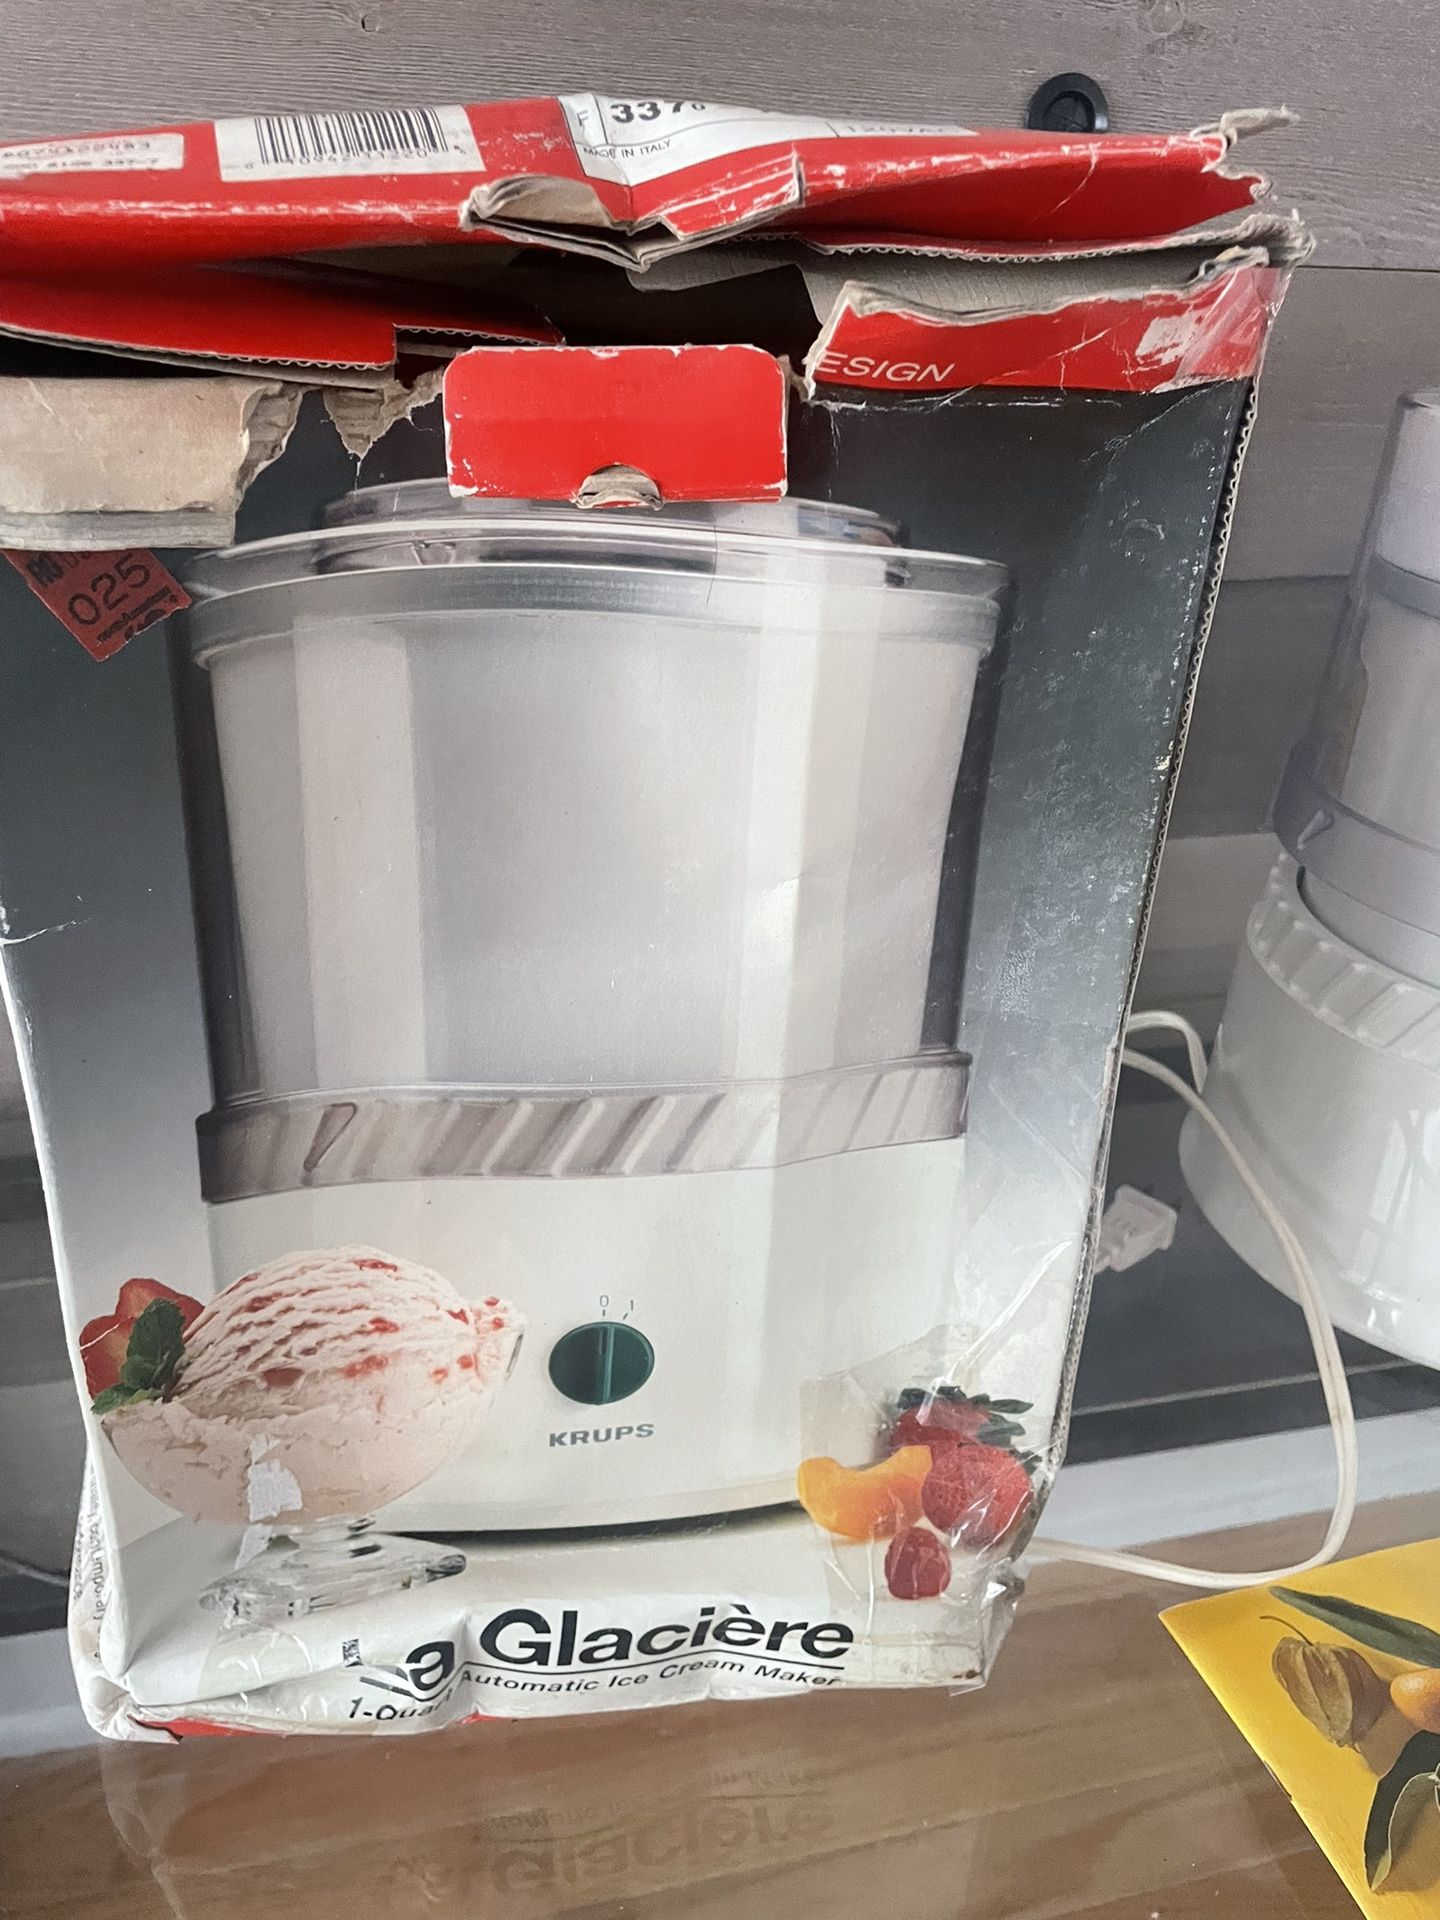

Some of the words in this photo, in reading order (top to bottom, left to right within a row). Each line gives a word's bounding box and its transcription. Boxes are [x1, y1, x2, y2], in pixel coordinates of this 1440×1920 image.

[621, 148, 635, 158] IN
[640, 138, 672, 155] ITALY
[68, 552, 151, 626] 025
[549, 1423, 655, 1448] KRUPS
[479, 1603, 854, 1667] Glacière
[460, 1670, 600, 1693] Automatic
[609, 1672, 649, 1689] Ice
[659, 1659, 746, 1680] Cream
[753, 1664, 843, 1687] Maker
